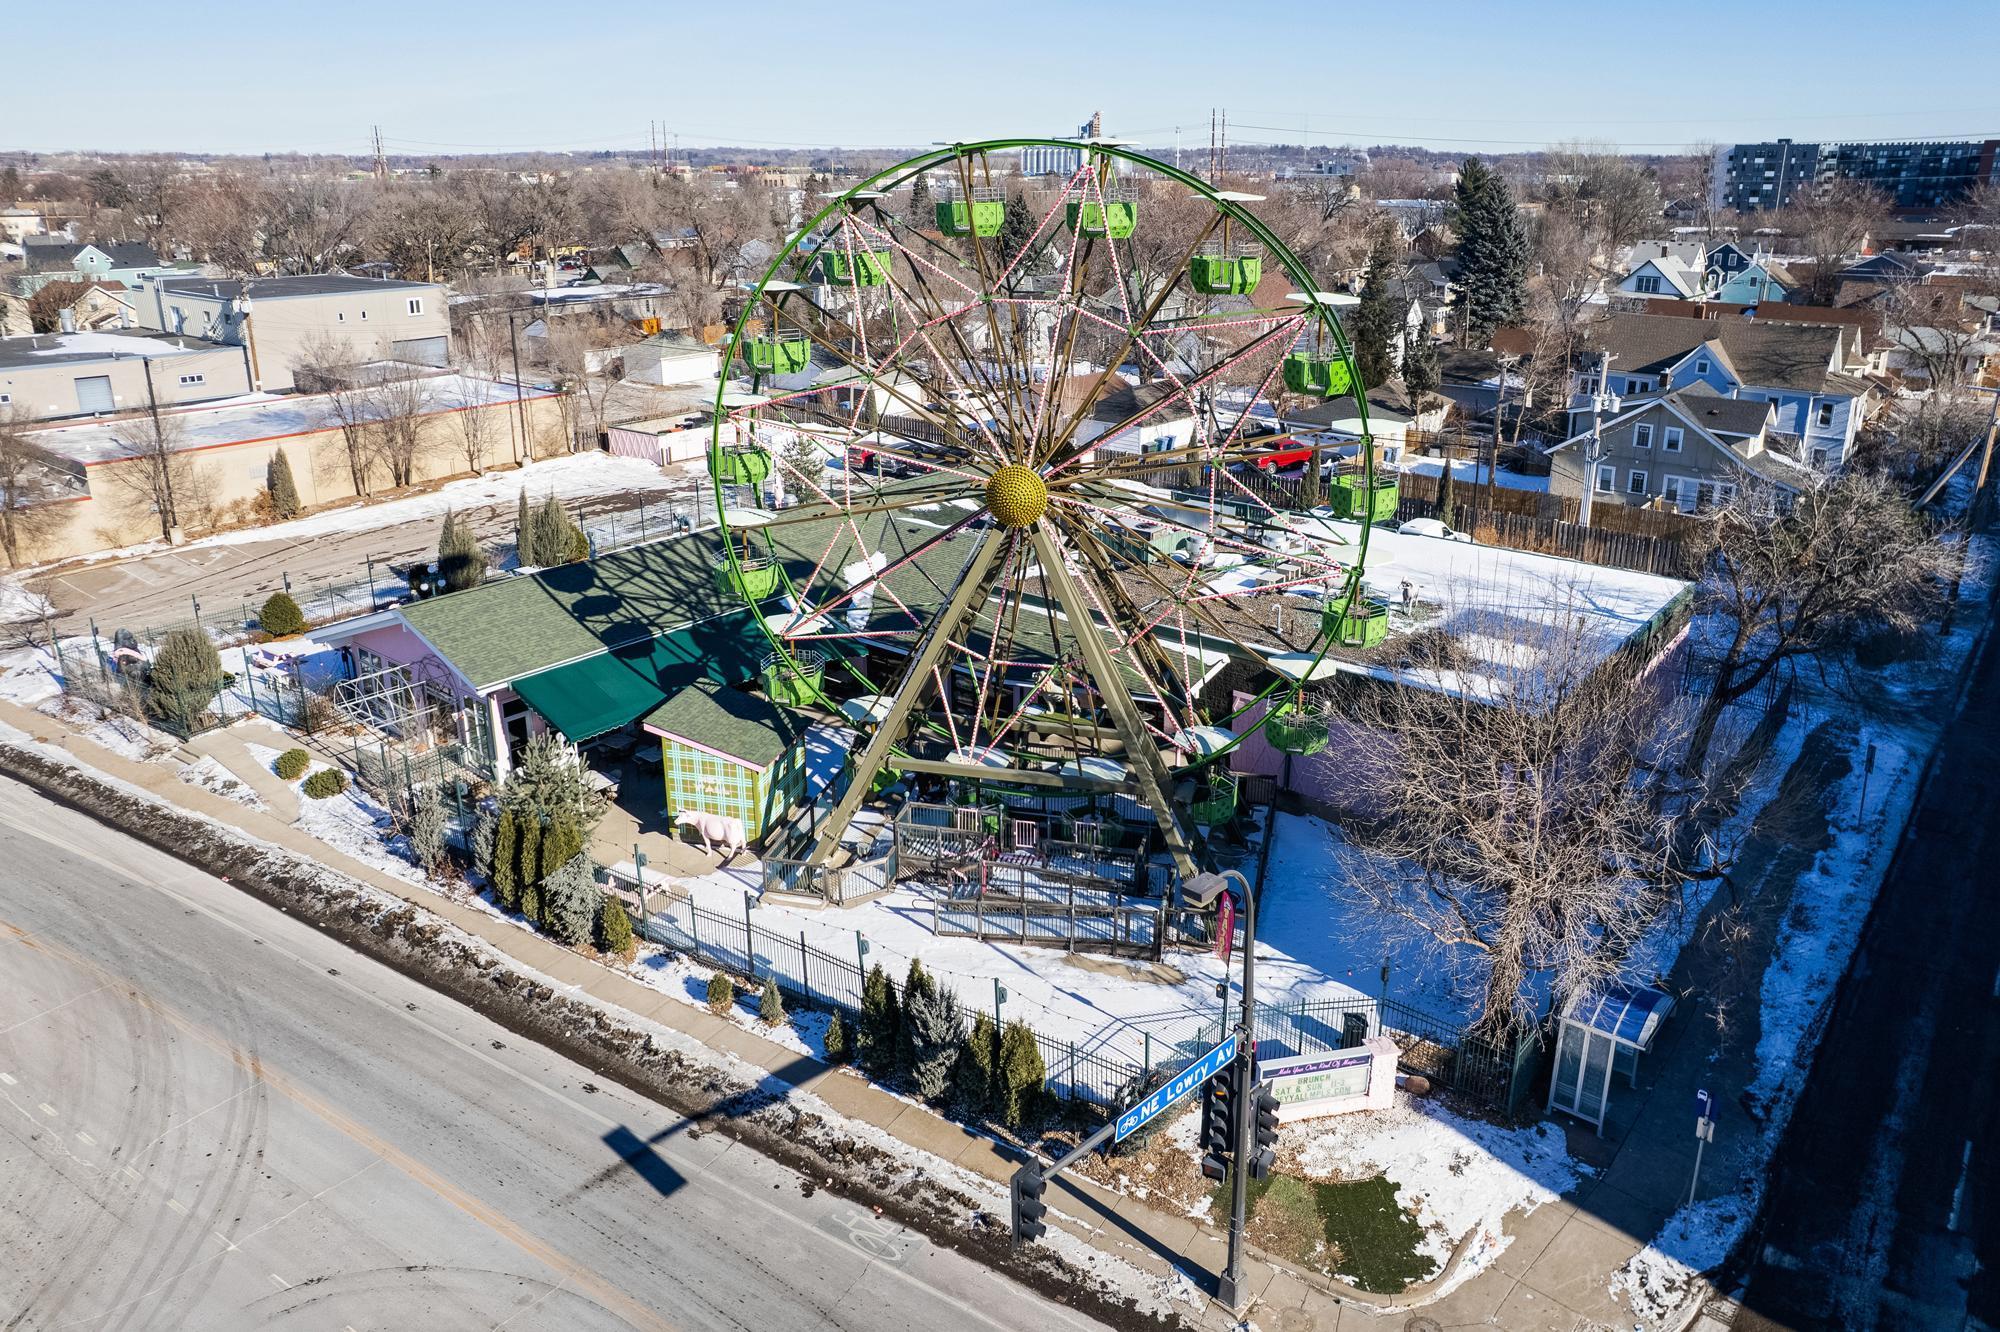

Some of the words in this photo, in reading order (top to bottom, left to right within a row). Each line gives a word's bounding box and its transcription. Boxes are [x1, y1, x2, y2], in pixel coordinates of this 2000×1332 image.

[1293, 1065, 1304, 1074] Your
[1305, 1063, 1317, 1071] Own
[1319, 1060, 1331, 1069] Kind
[1331, 1059, 1341, 1069] Of
[1140, 1096, 1159, 1120] NE
[1166, 1062, 1209, 1102] Lowry
[1215, 1044, 1233, 1067] Av
[1297, 1074, 1331, 1085] BRUNCH
[1275, 1086, 1291, 1097] SAT
[1295, 1085, 1302, 1094] &
[1306, 1081, 1323, 1093] SUN
